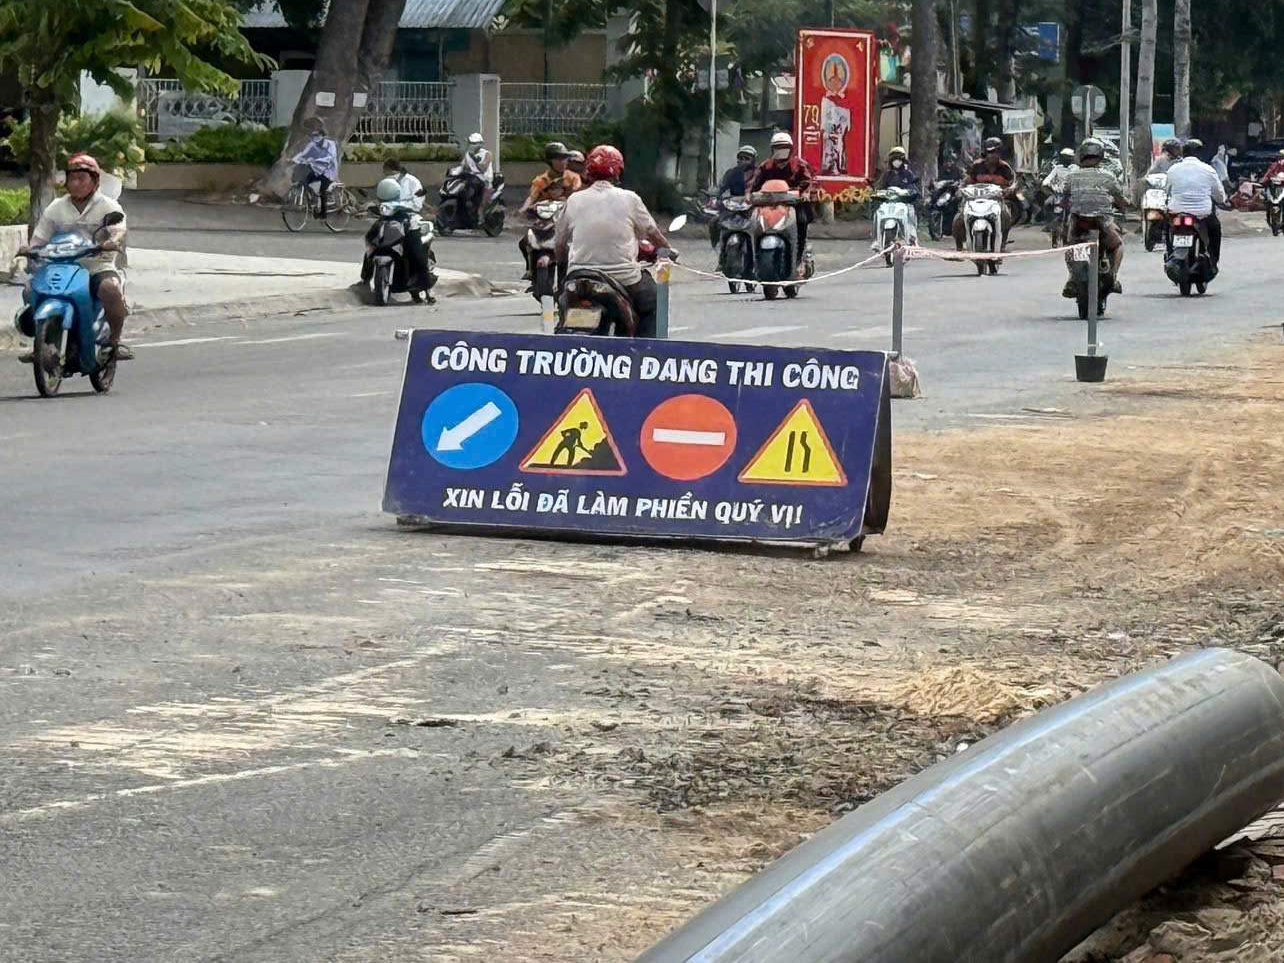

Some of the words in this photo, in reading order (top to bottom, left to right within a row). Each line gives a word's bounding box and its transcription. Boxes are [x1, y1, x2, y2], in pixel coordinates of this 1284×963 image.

[431, 341, 508, 374] CÔNG
[516, 347, 631, 380] TRƯỜNG
[640, 357, 718, 385] ĐANG
[726, 360, 772, 387] THI
[782, 358, 860, 390] CÔNG
[442, 488, 485, 510] XIN
[491, 481, 529, 512] LỖI
[536, 487, 569, 513] ĐÃ
[577, 490, 629, 517] LÀM
[635, 491, 707, 520] PHIỀN
[714, 498, 765, 526] QUÝ
